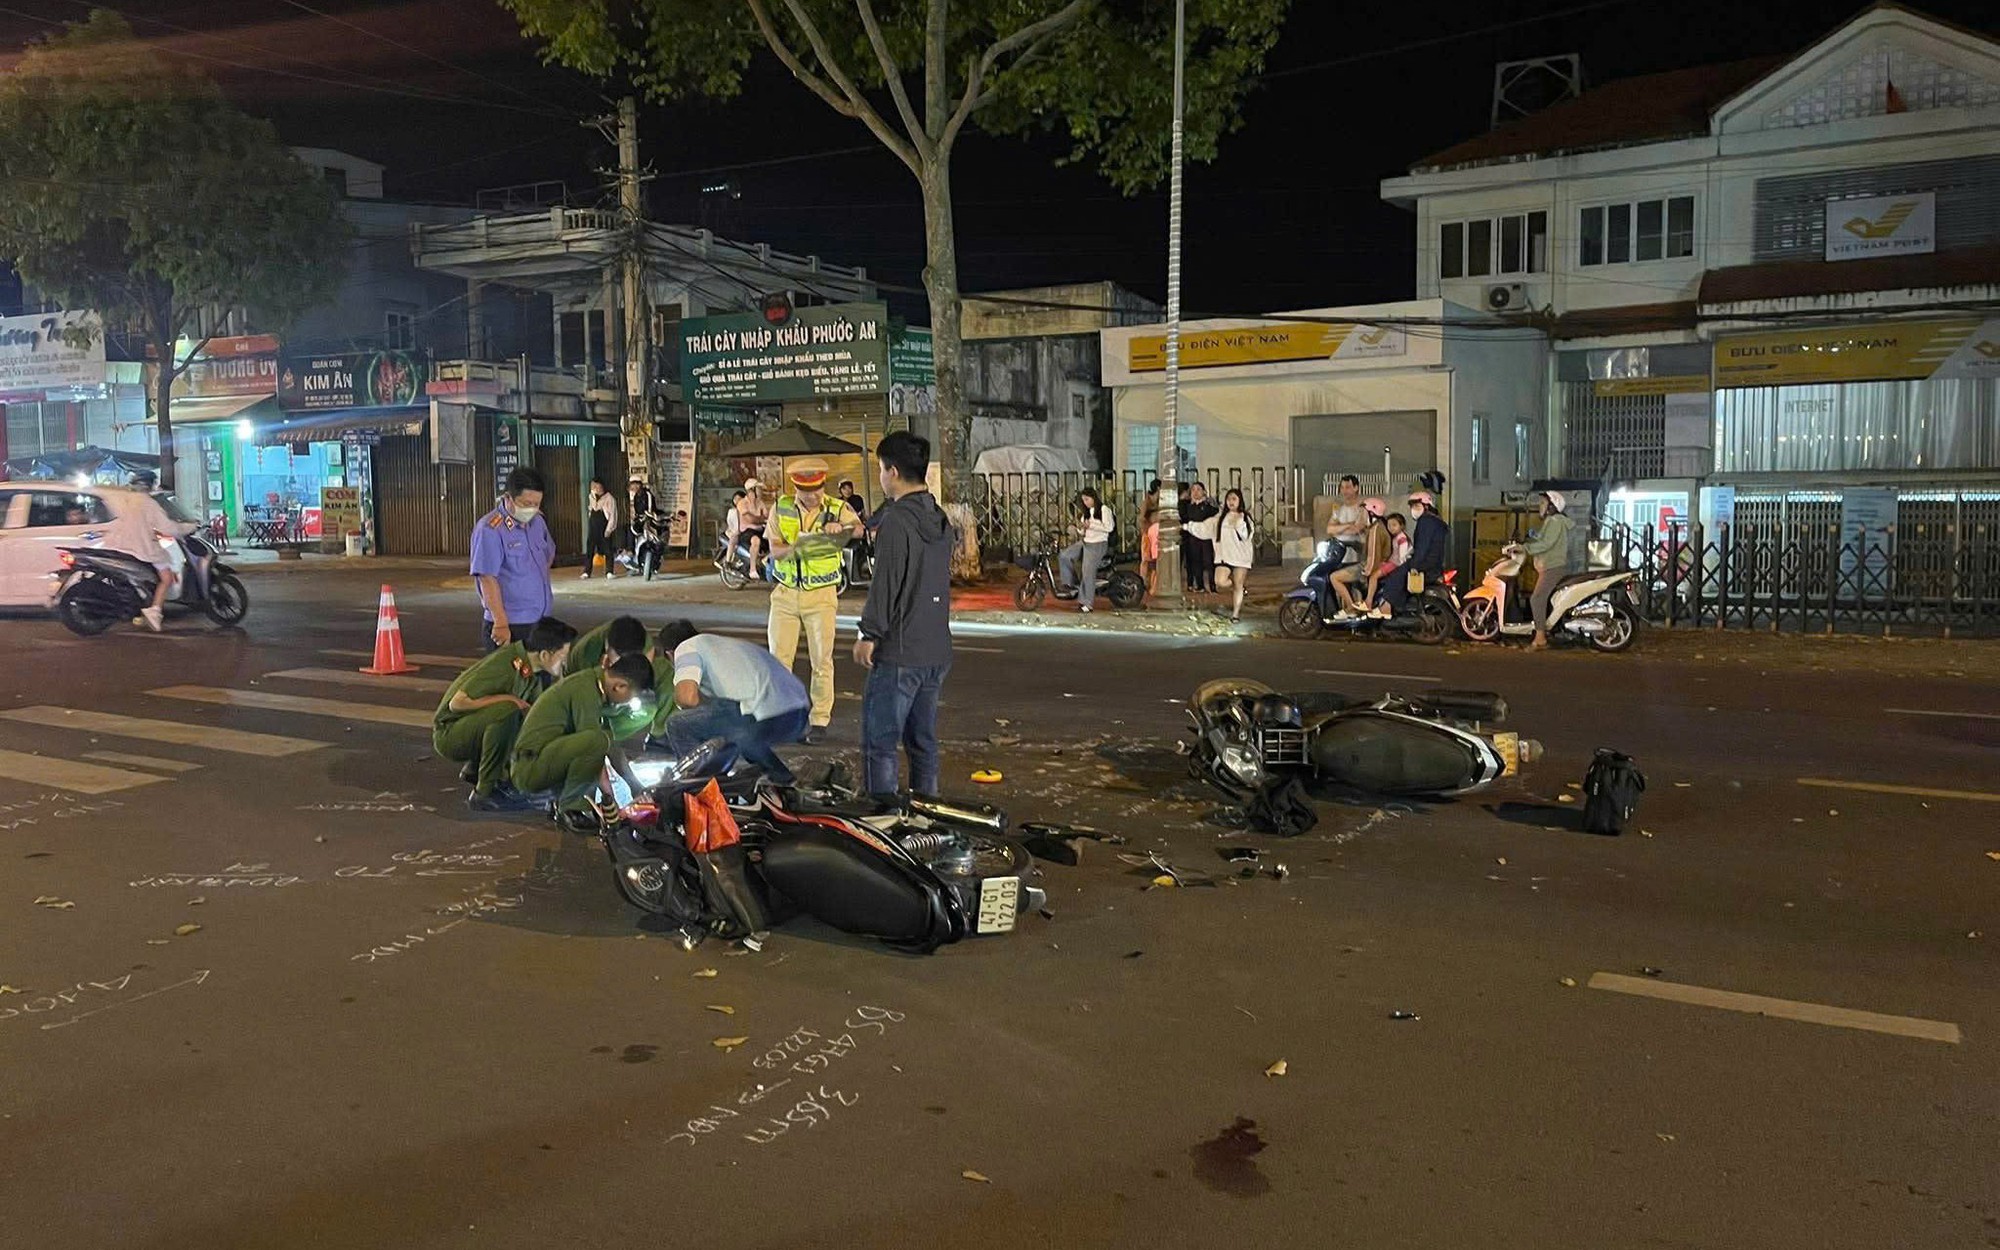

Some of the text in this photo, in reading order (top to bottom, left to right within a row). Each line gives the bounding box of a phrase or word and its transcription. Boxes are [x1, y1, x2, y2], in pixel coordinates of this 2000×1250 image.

[686, 316, 877, 353] TRÁI CÂY NHẬP KHẨU PHƯỚC AN
[1225, 336, 1255, 348] VIỆT
[1259, 334, 1290, 344] NAM
[304, 375, 330, 390] KIM
[1784, 399, 1834, 413] INTERNET
